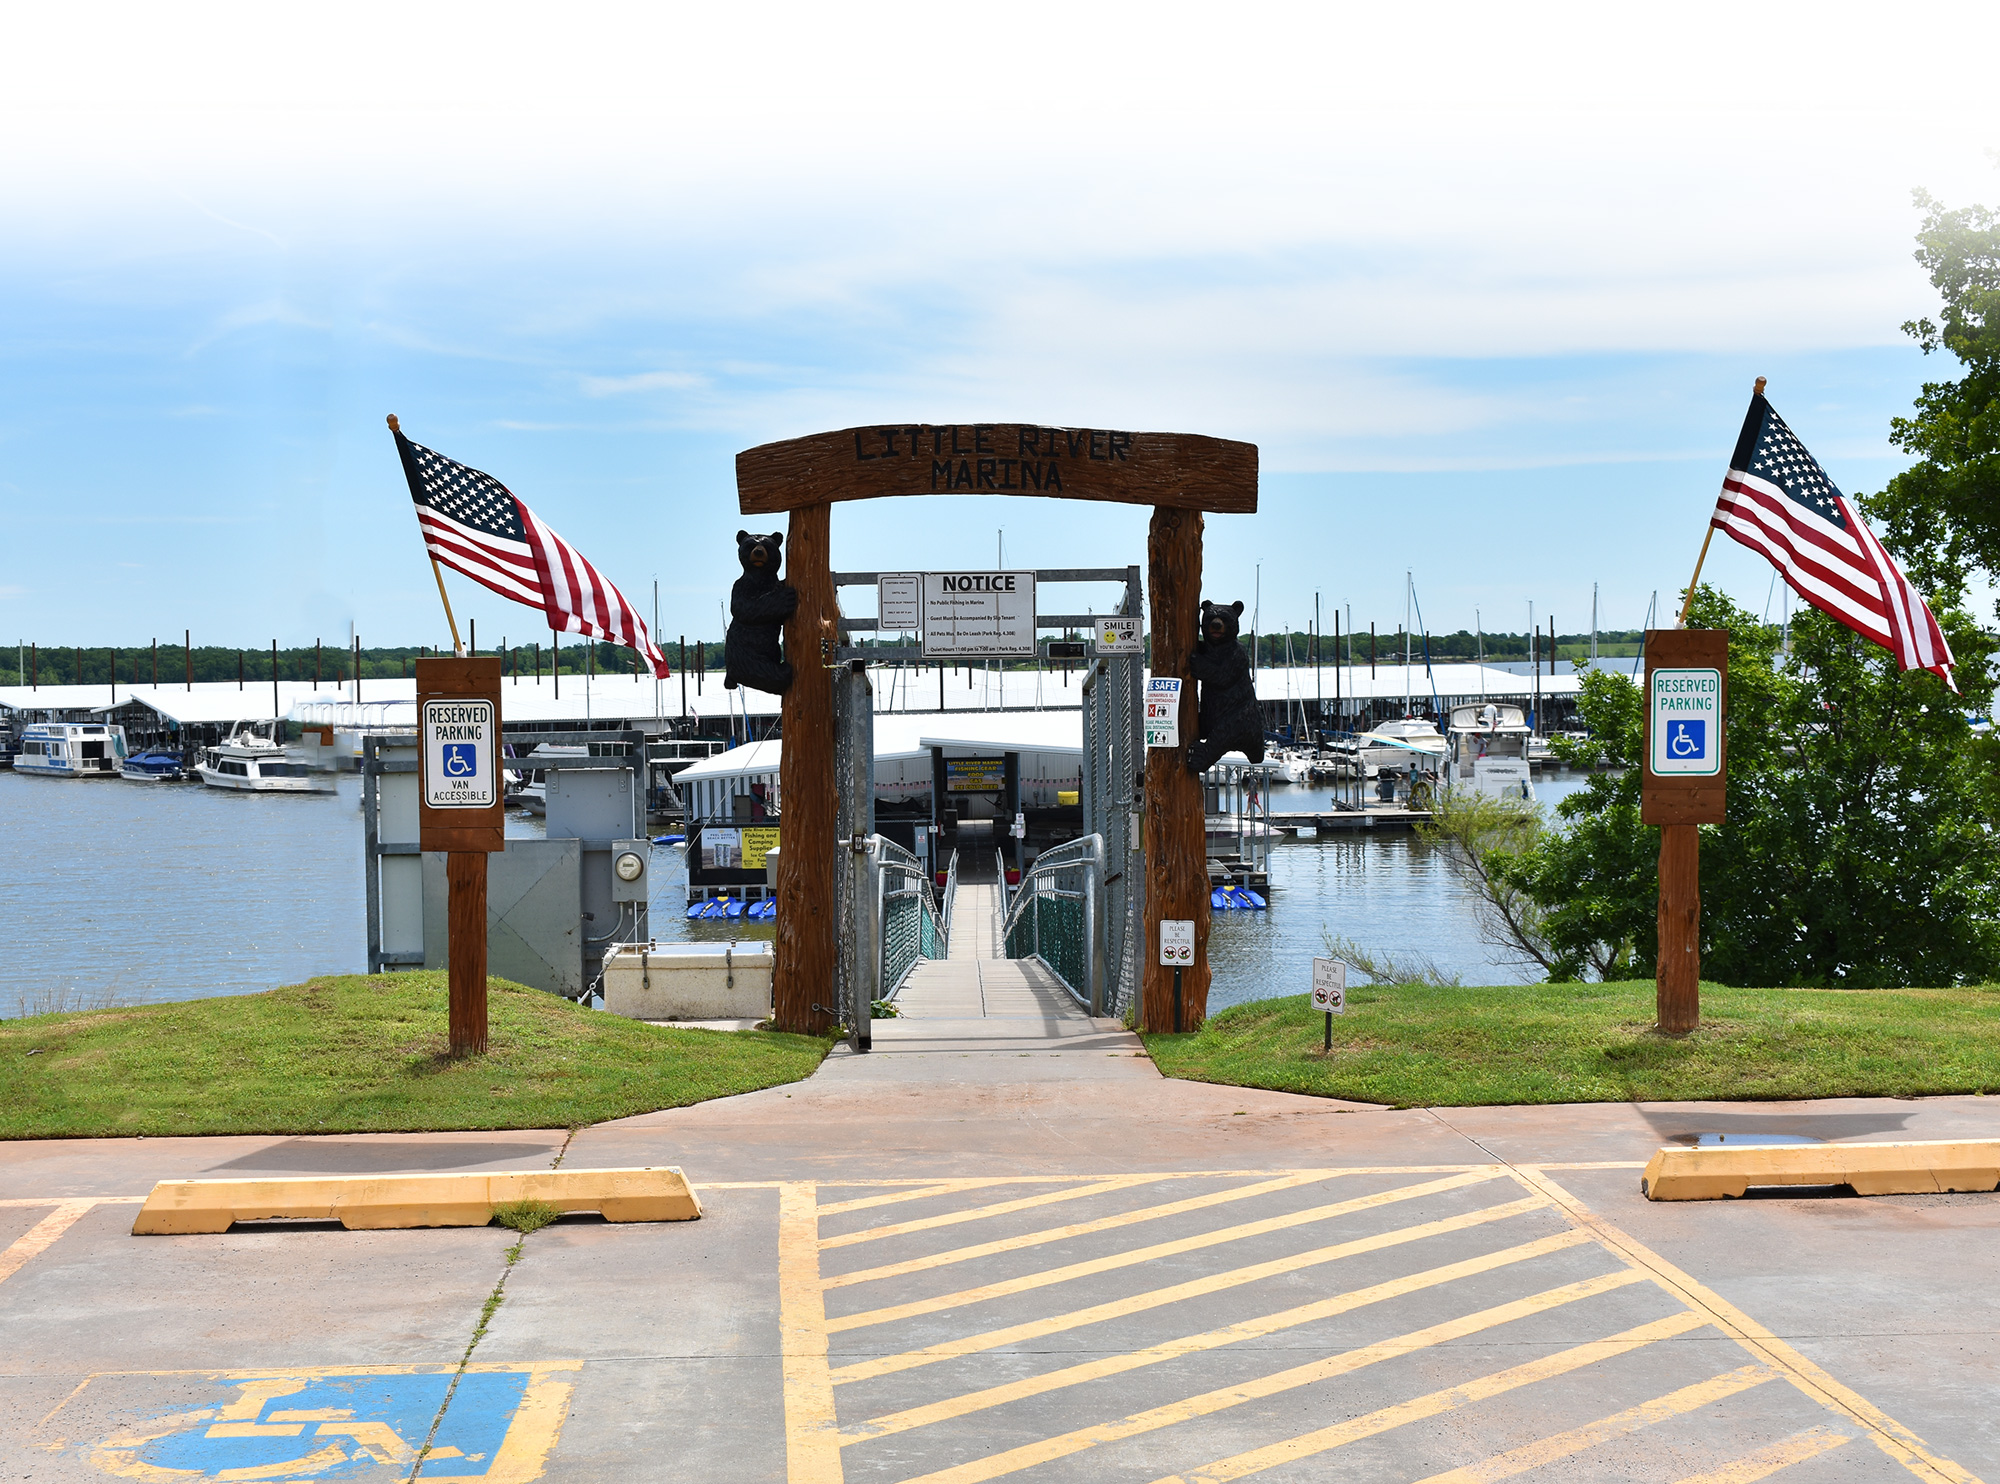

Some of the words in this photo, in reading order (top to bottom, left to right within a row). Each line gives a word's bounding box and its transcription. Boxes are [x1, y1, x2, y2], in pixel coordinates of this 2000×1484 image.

[855, 426, 995, 461] LITTLE
[1018, 427, 1130, 461] RIVER
[931, 459, 1063, 492] MARINA
[942, 576, 1016, 591] NOTICE
[1104, 622, 1135, 630] SMILE!
[1155, 681, 1176, 690] SAFE
[1658, 679, 1716, 692] RESERVED
[1661, 697, 1712, 710] PARKING
[430, 707, 488, 723] RESERVED
[436, 726, 482, 740] PARKING
[452, 780, 469, 789] VAN
[434, 791, 487, 800] ACCESSIBLE
[1322, 965, 1337, 973] PLEASE
[1316, 979, 1341, 989] RESPECTFUL
